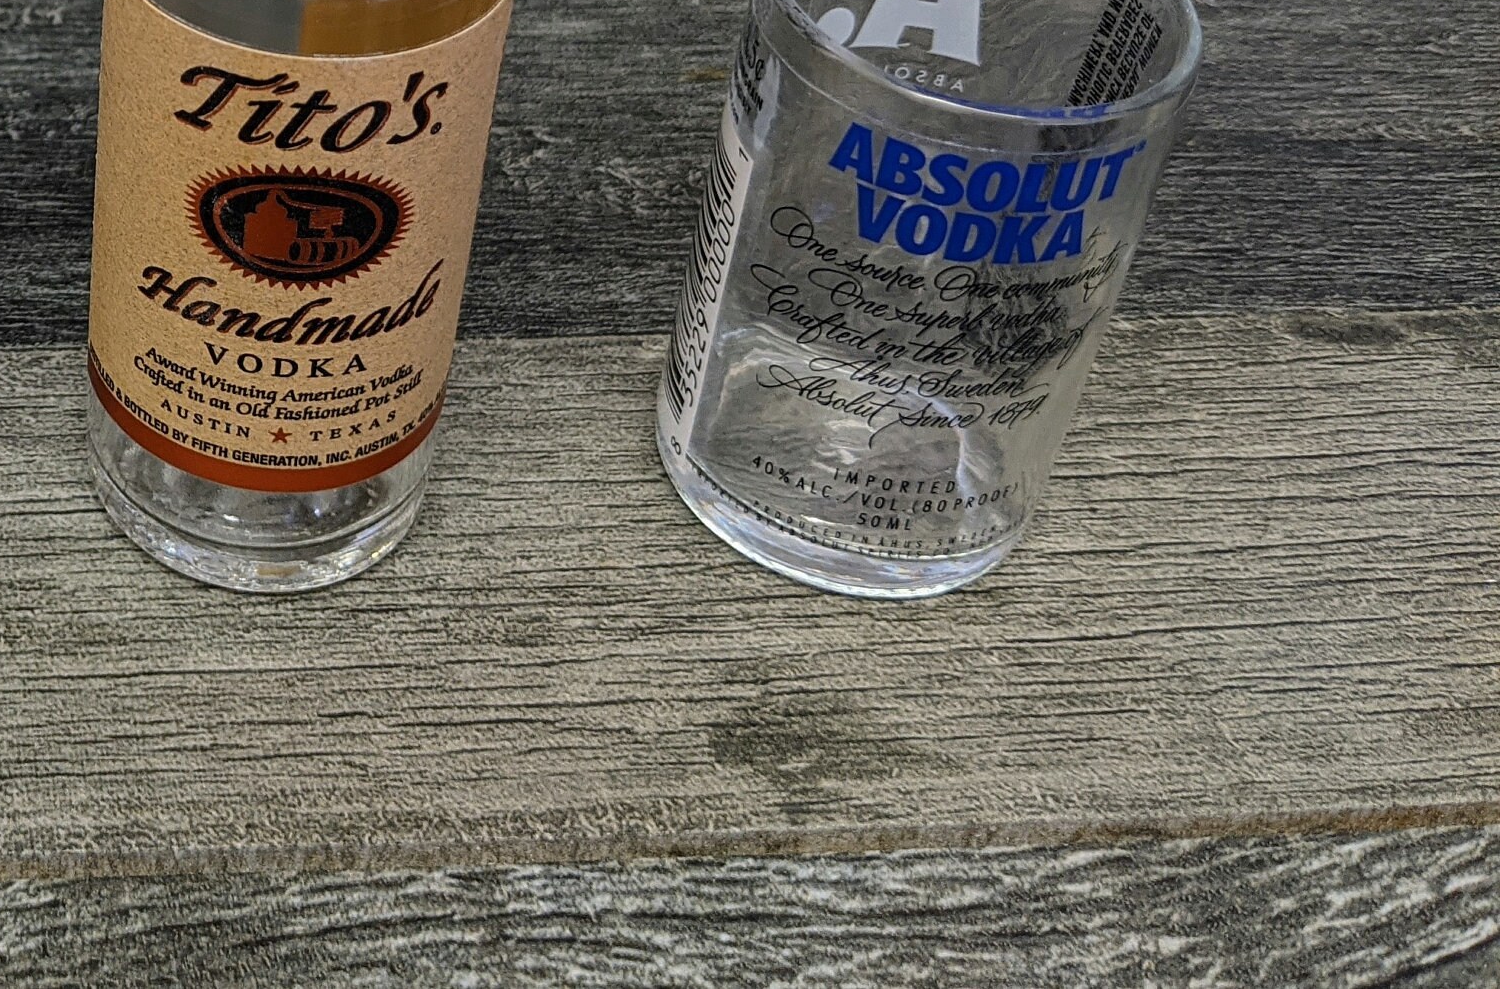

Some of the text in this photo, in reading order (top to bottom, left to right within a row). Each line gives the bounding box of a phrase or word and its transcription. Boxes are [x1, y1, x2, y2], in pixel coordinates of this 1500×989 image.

[828, 122, 1136, 213] ABSOLUT
[770, 206, 838, 261] One
[934, 265, 999, 302] One
[856, 180, 1085, 264] VODKA
[137, 258, 444, 346] Handmade
[751, 264, 884, 350] Crafted
[876, 336, 905, 358] in
[908, 333, 967, 365] the
[808, 268, 889, 318] One
[134, 355, 184, 394] Crafted
[187, 386, 205, 403] in
[209, 396, 231, 411] an
[236, 401, 272, 419] Old
[274, 399, 362, 421] Fashioned
[364, 391, 391, 411] Pot
[393, 368, 424, 399] Still
[145, 347, 414, 404] Award Winning American Vodka
[203, 341, 367, 378] VODKA
[116, 388, 123, 402] &
[124, 394, 169, 435] BOTTLED
[172, 428, 189, 444] BY
[192, 437, 228, 458] FIFTH
[232, 450, 322, 467] GENERATION,
[326, 450, 352, 463] INC.
[355, 431, 399, 458] AUSTIN,
[161, 398, 396, 442] AUSTIN TEXAS
[756, 364, 900, 428] Absolut
[875, 390, 984, 441] Since
[752, 455, 790, 483] 40%
[833, 468, 957, 494] IMPORTED
